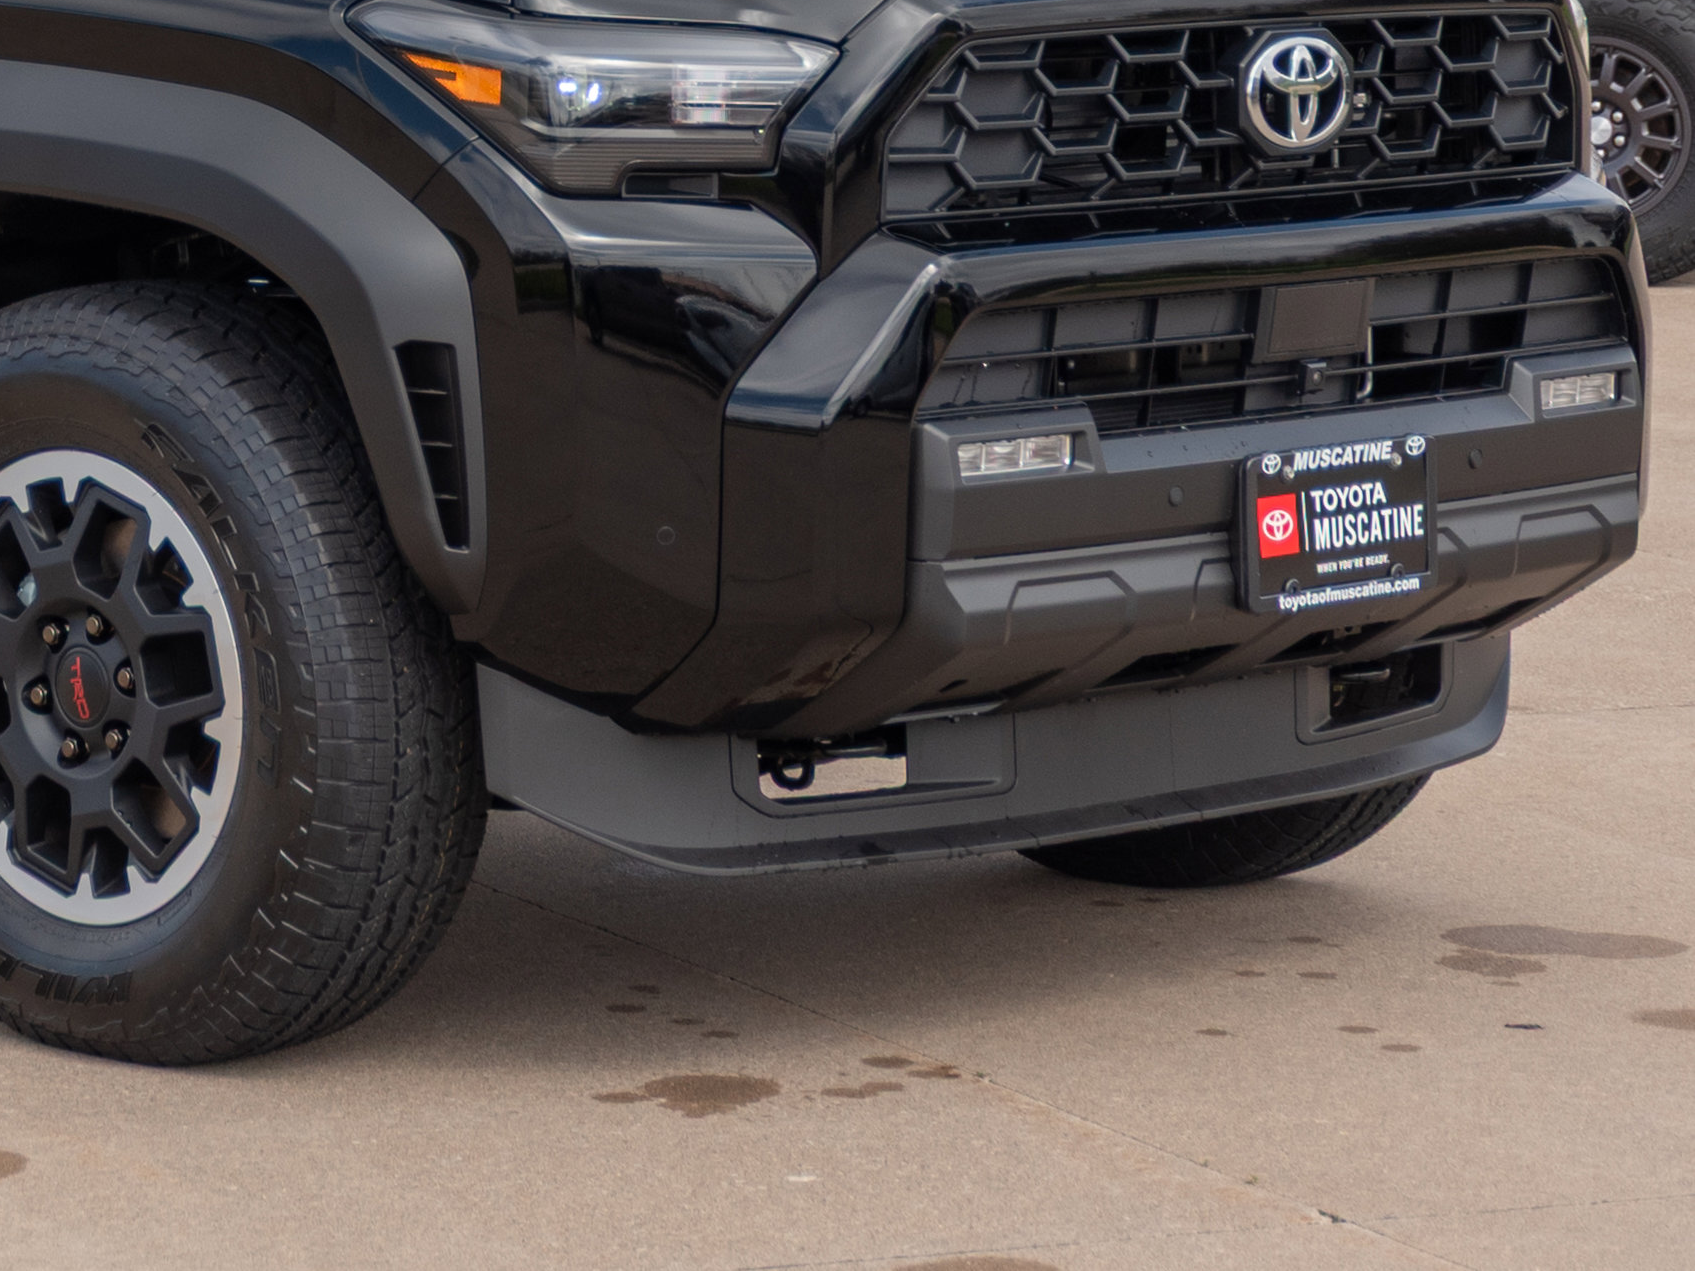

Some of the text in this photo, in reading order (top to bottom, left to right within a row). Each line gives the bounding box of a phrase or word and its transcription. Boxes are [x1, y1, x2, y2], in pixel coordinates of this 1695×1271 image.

[1293, 441, 1393, 471] MUSCATINE
[1310, 481, 1387, 513] TOYOTA
[1314, 504, 1424, 551] MUSCATINE
[139, 420, 283, 788] FALKEN
[1278, 577, 1420, 611] toyotaofmuscatine.com
[69, 655, 91, 720] TRD
